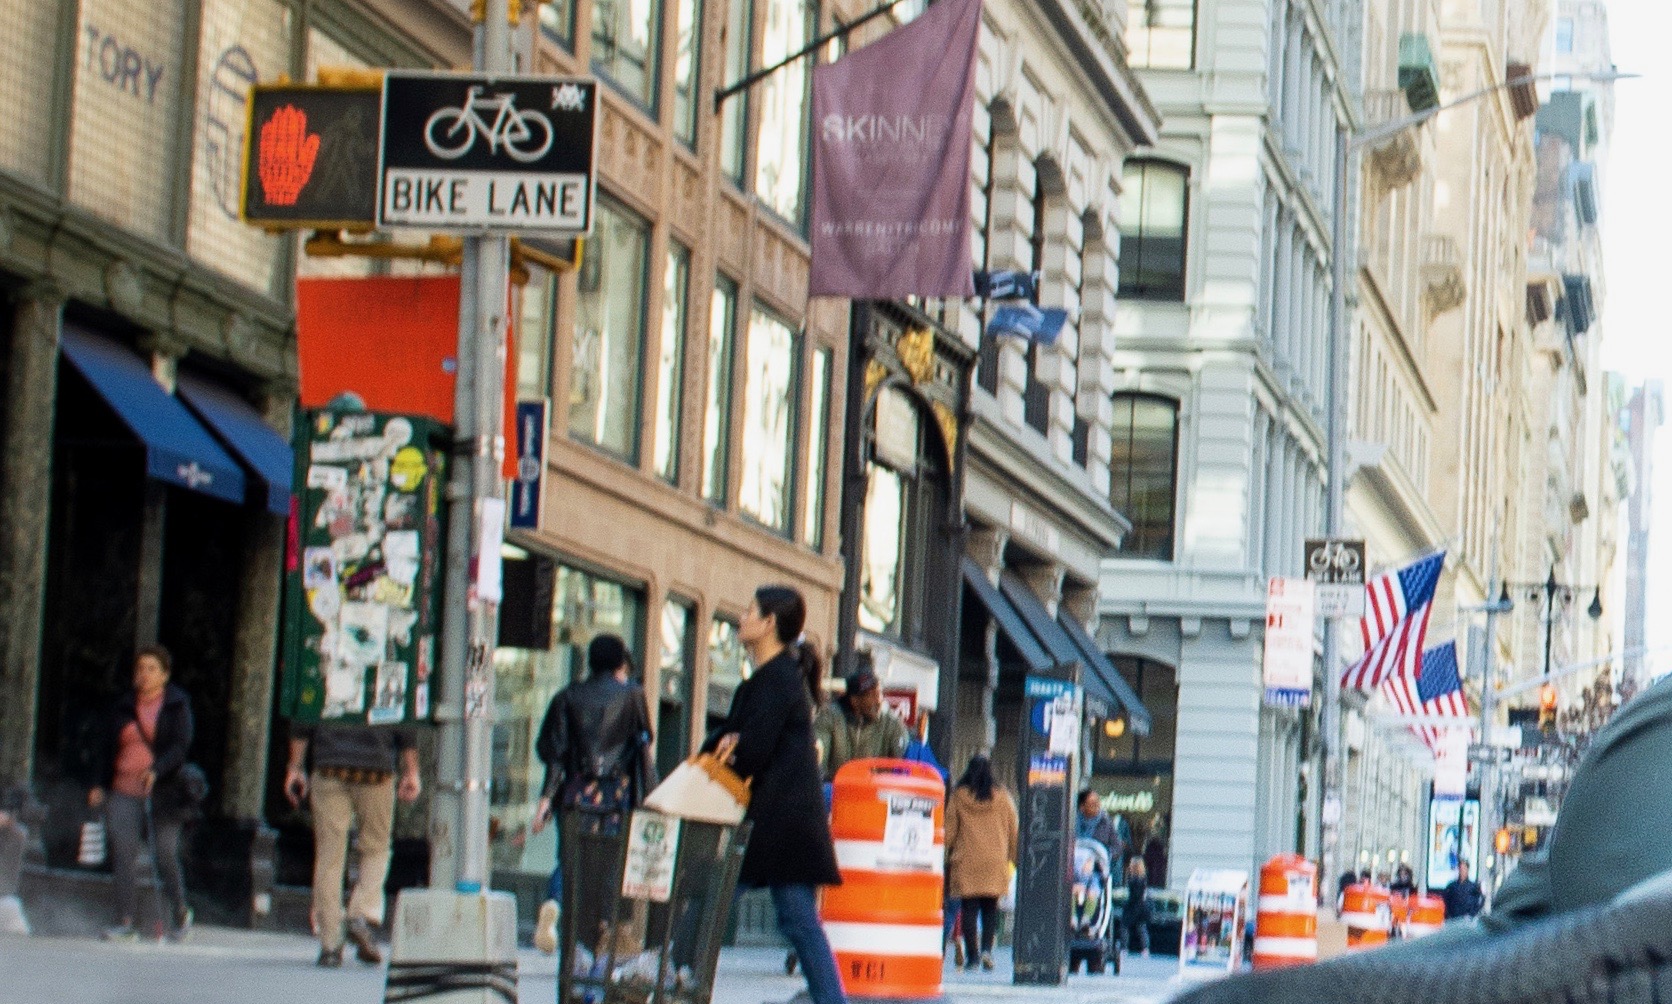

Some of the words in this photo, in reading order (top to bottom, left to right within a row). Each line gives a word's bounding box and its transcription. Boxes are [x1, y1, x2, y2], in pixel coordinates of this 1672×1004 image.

[85, 23, 163, 105] TORY
[391, 176, 468, 214] BIKE
[487, 180, 579, 218] LANE
